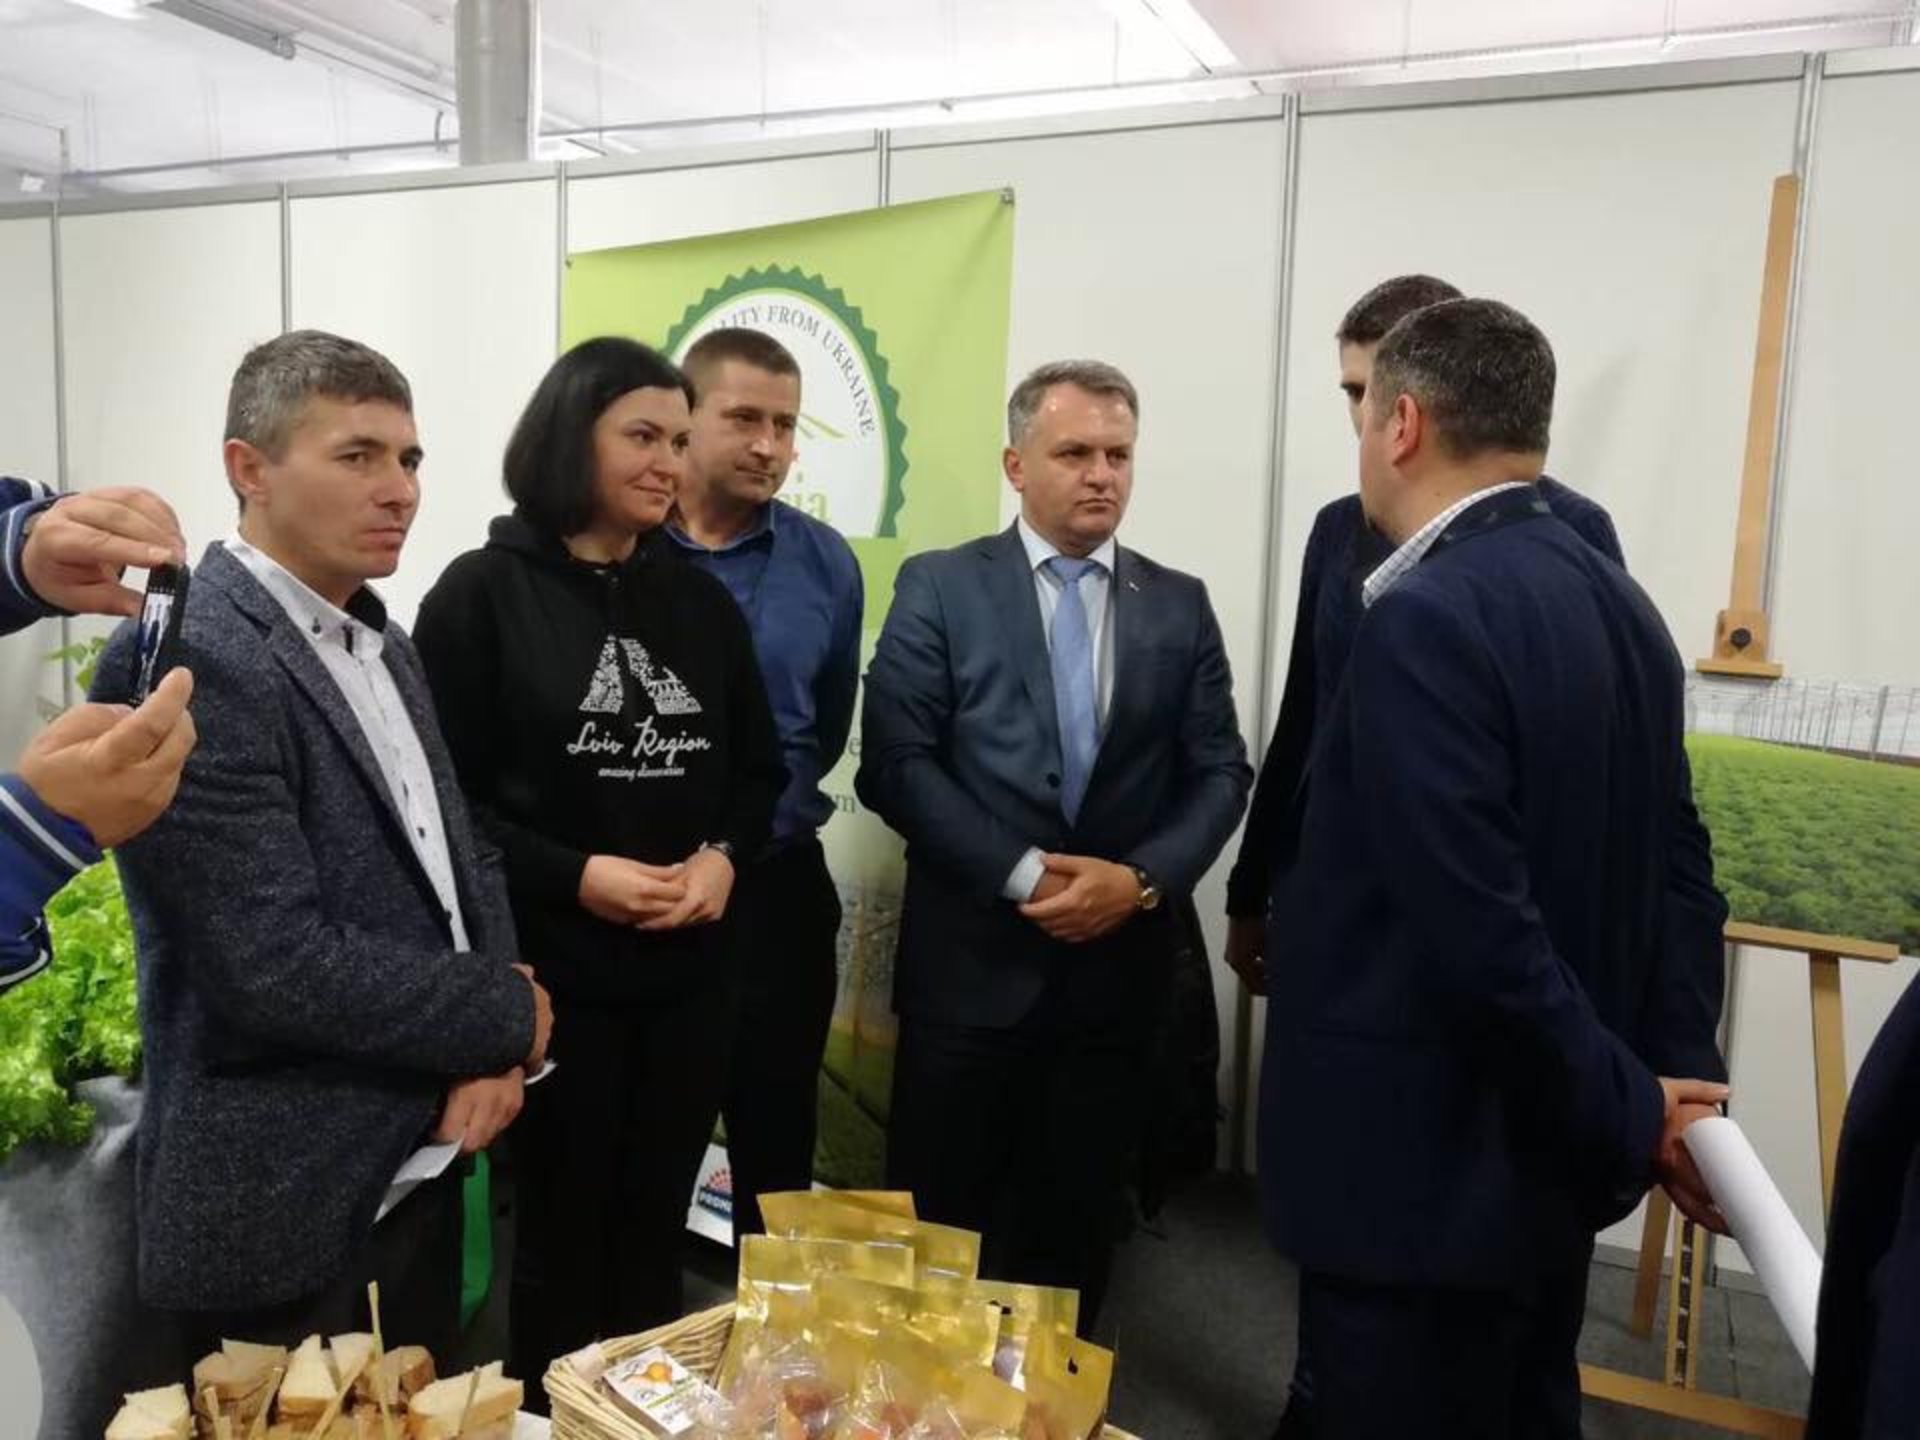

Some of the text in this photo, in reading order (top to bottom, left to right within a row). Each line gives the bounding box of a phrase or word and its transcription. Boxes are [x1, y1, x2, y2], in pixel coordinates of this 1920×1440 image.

[767, 305, 820, 337] FROM
[822, 329, 876, 438] UKRAINE
[632, 714, 712, 767] Region
